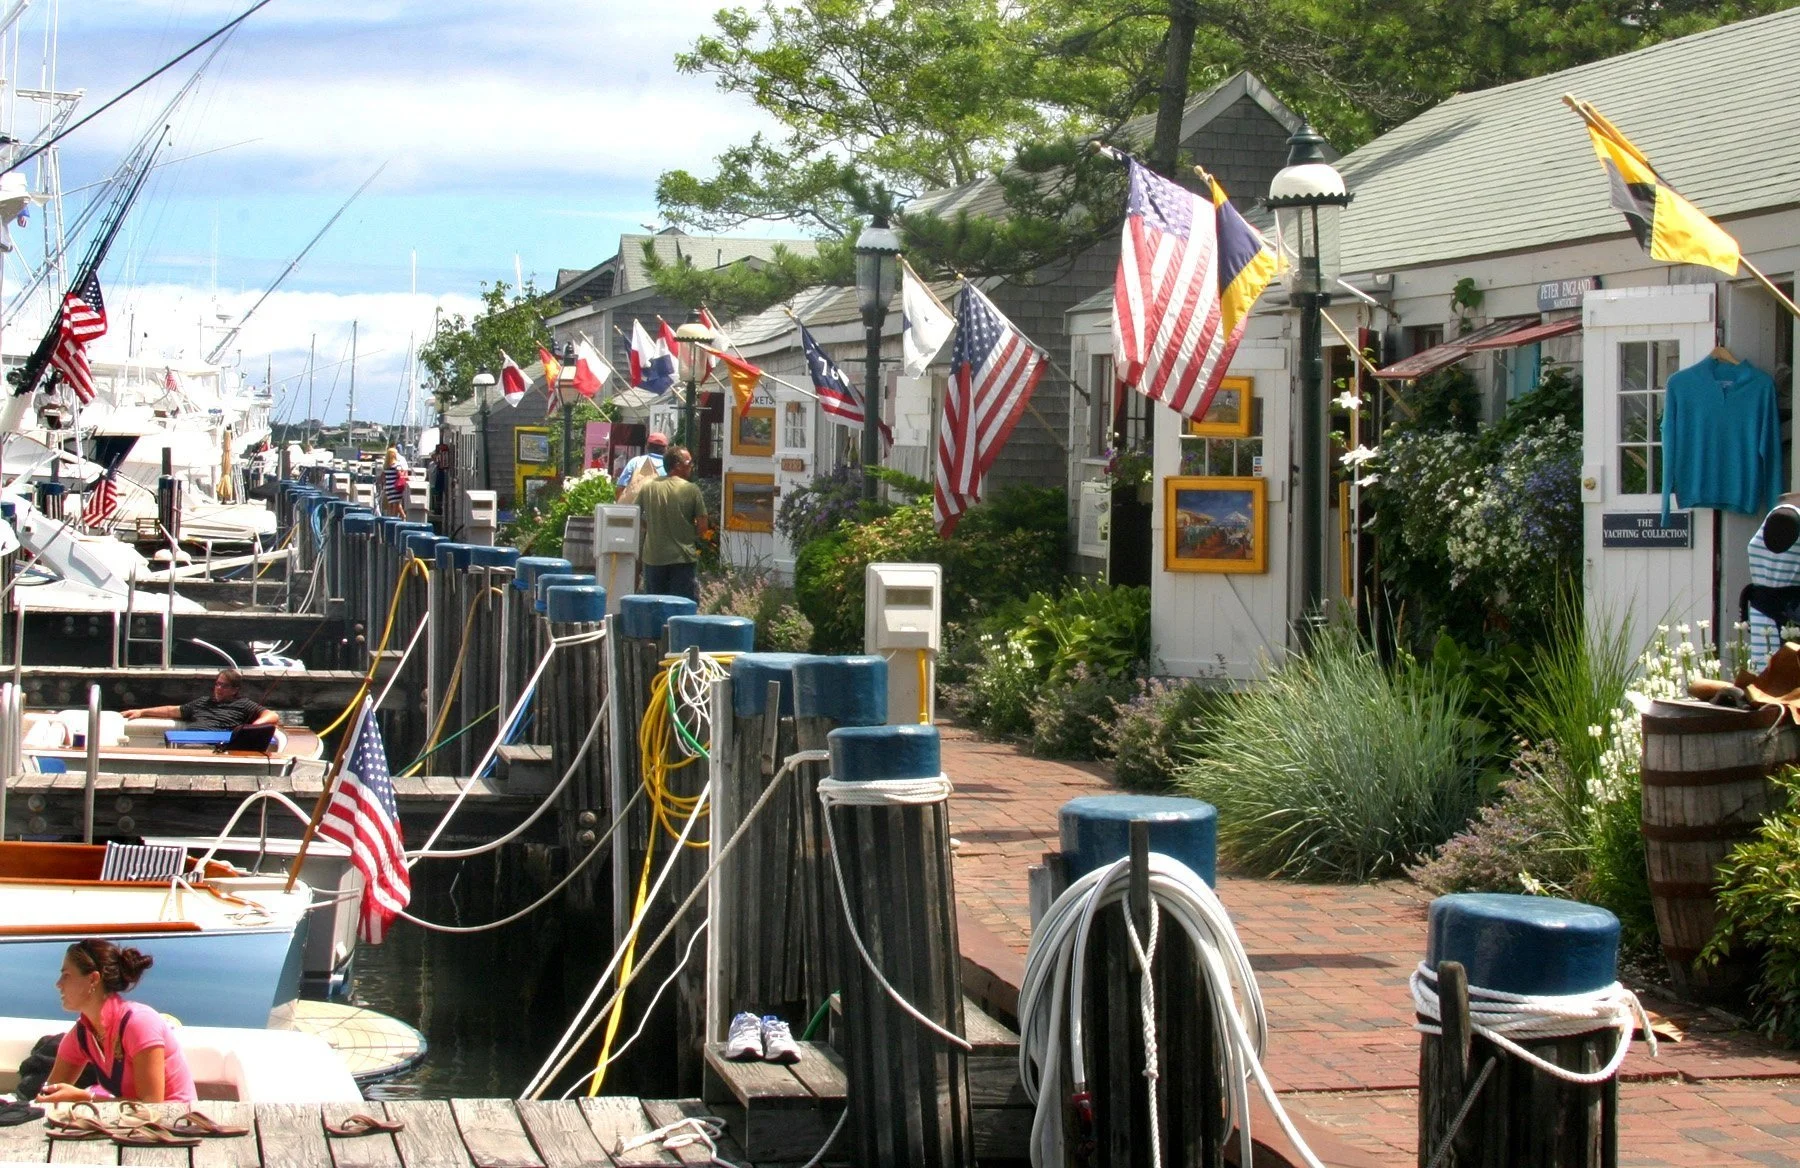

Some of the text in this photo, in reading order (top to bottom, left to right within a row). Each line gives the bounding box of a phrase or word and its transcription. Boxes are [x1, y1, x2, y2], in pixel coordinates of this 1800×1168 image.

[1541, 279, 1591, 300] PETER ENGLAND
[818, 356, 839, 380] 76
[1637, 518, 1654, 528] THE
[1604, 528, 1688, 539] YACHTING COLLECTION
